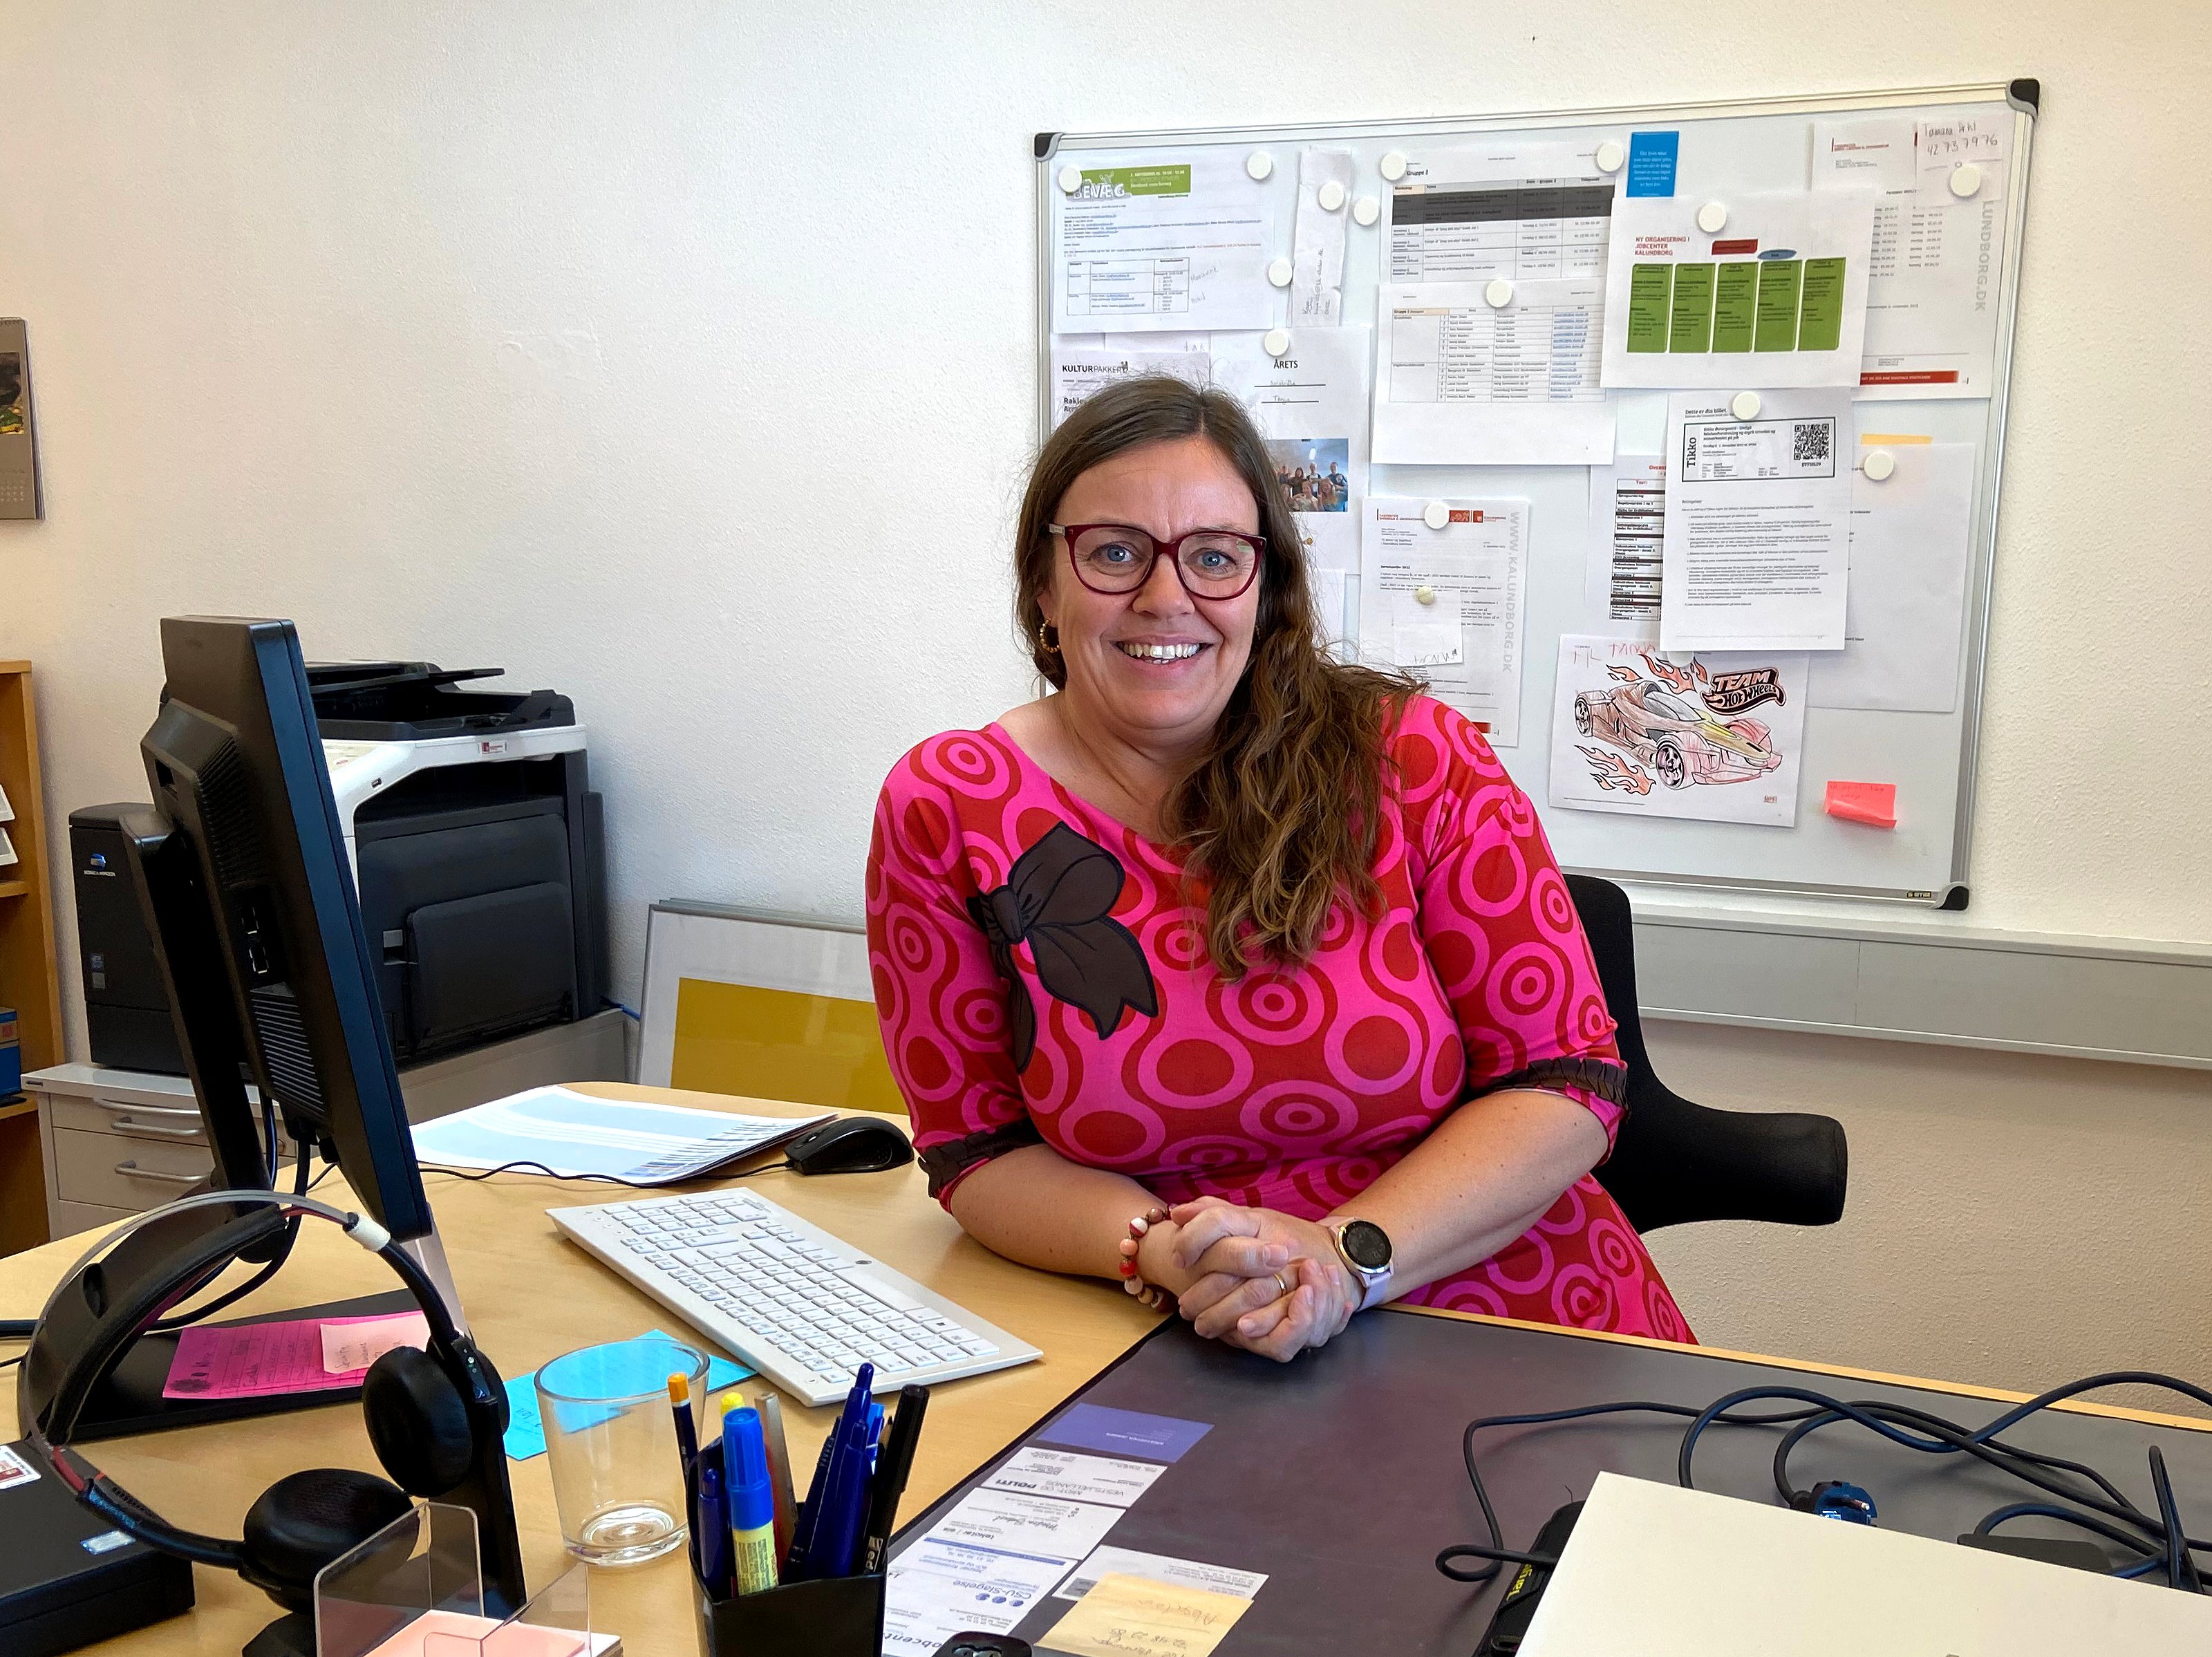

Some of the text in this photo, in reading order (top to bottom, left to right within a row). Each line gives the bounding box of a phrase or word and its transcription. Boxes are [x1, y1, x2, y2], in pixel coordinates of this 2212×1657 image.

[1944, 140, 1959, 152] 73
[1982, 133, 1998, 145] 76
[1273, 358, 1298, 369] ÅRETS
[1686, 437, 1696, 468] Tikko
[1502, 512, 1520, 673] WWW.KALUNDBORG.DK
[1714, 671, 1771, 692] TEAM
[1722, 691, 1744, 707] HOT
[952, 1579, 1031, 1599] CSU-Slagelse
[1506, 1564, 1533, 1602] Targ
[882, 1631, 941, 1648] obcent
